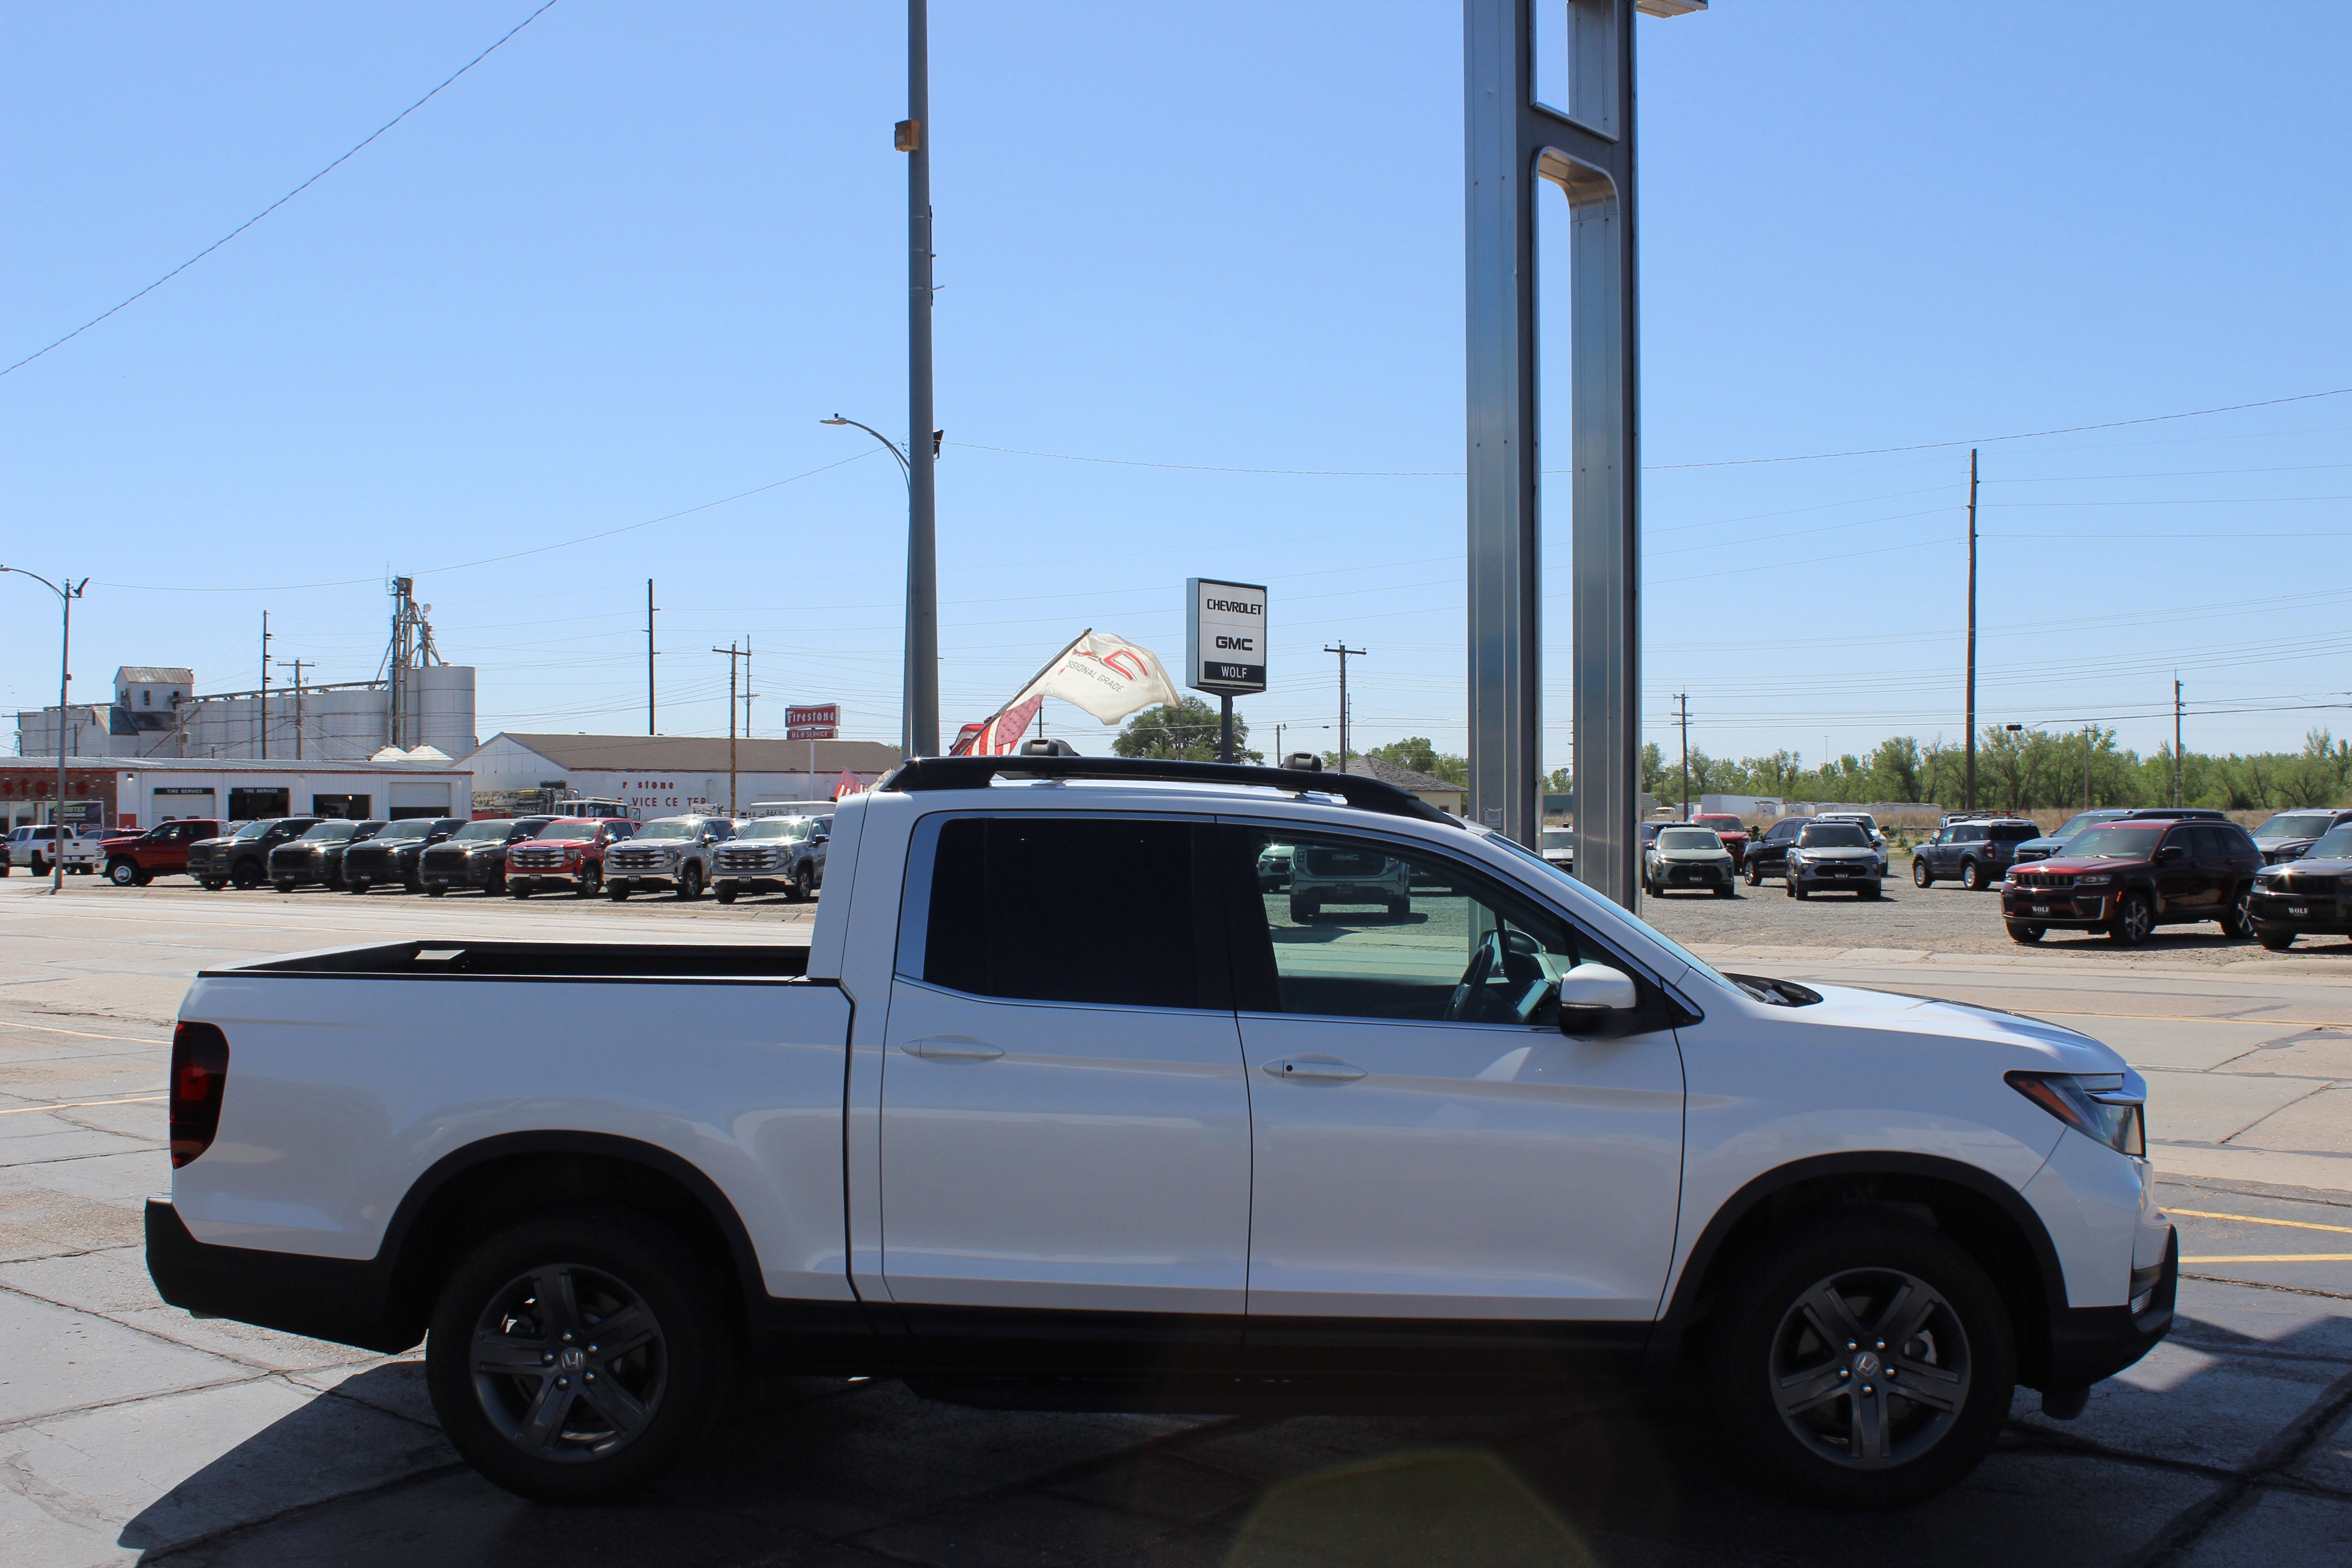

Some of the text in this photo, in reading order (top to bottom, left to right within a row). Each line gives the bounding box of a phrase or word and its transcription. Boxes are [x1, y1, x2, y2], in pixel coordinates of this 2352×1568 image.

[1207, 598, 1263, 615] CHEVROLET
[1216, 636, 1253, 651] GMC
[1221, 666, 1247, 678] WOLF
[1097, 675, 1125, 693] GRADE
[787, 710, 834, 724] Firestone
